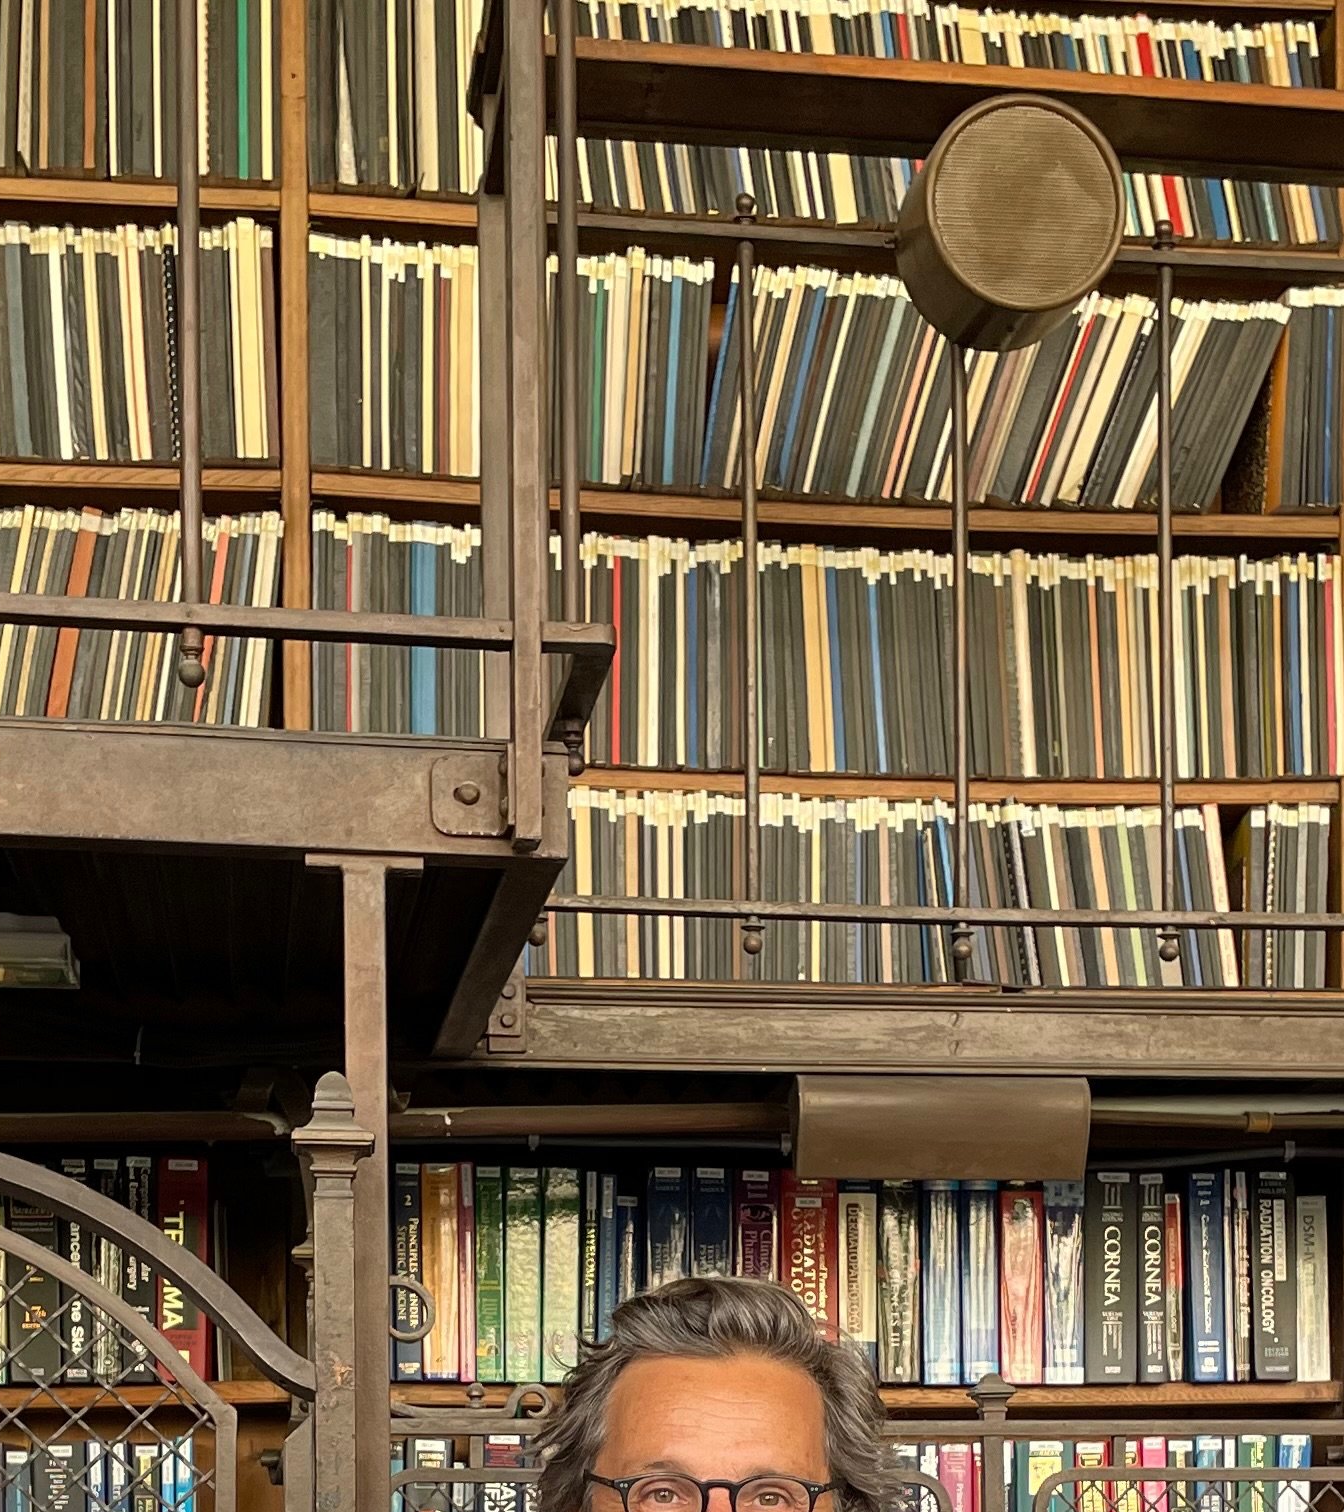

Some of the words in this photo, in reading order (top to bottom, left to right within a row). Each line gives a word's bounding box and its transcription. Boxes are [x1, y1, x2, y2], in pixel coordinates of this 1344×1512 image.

[584, 1228, 596, 1287] MYELOMA
[1259, 1199, 1272, 1264] RADIATION
[1103, 1225, 1121, 1307] CORNEA
[1144, 1225, 1162, 1307] CORNEA
[1261, 1269, 1275, 1335] ONCOLOGY
